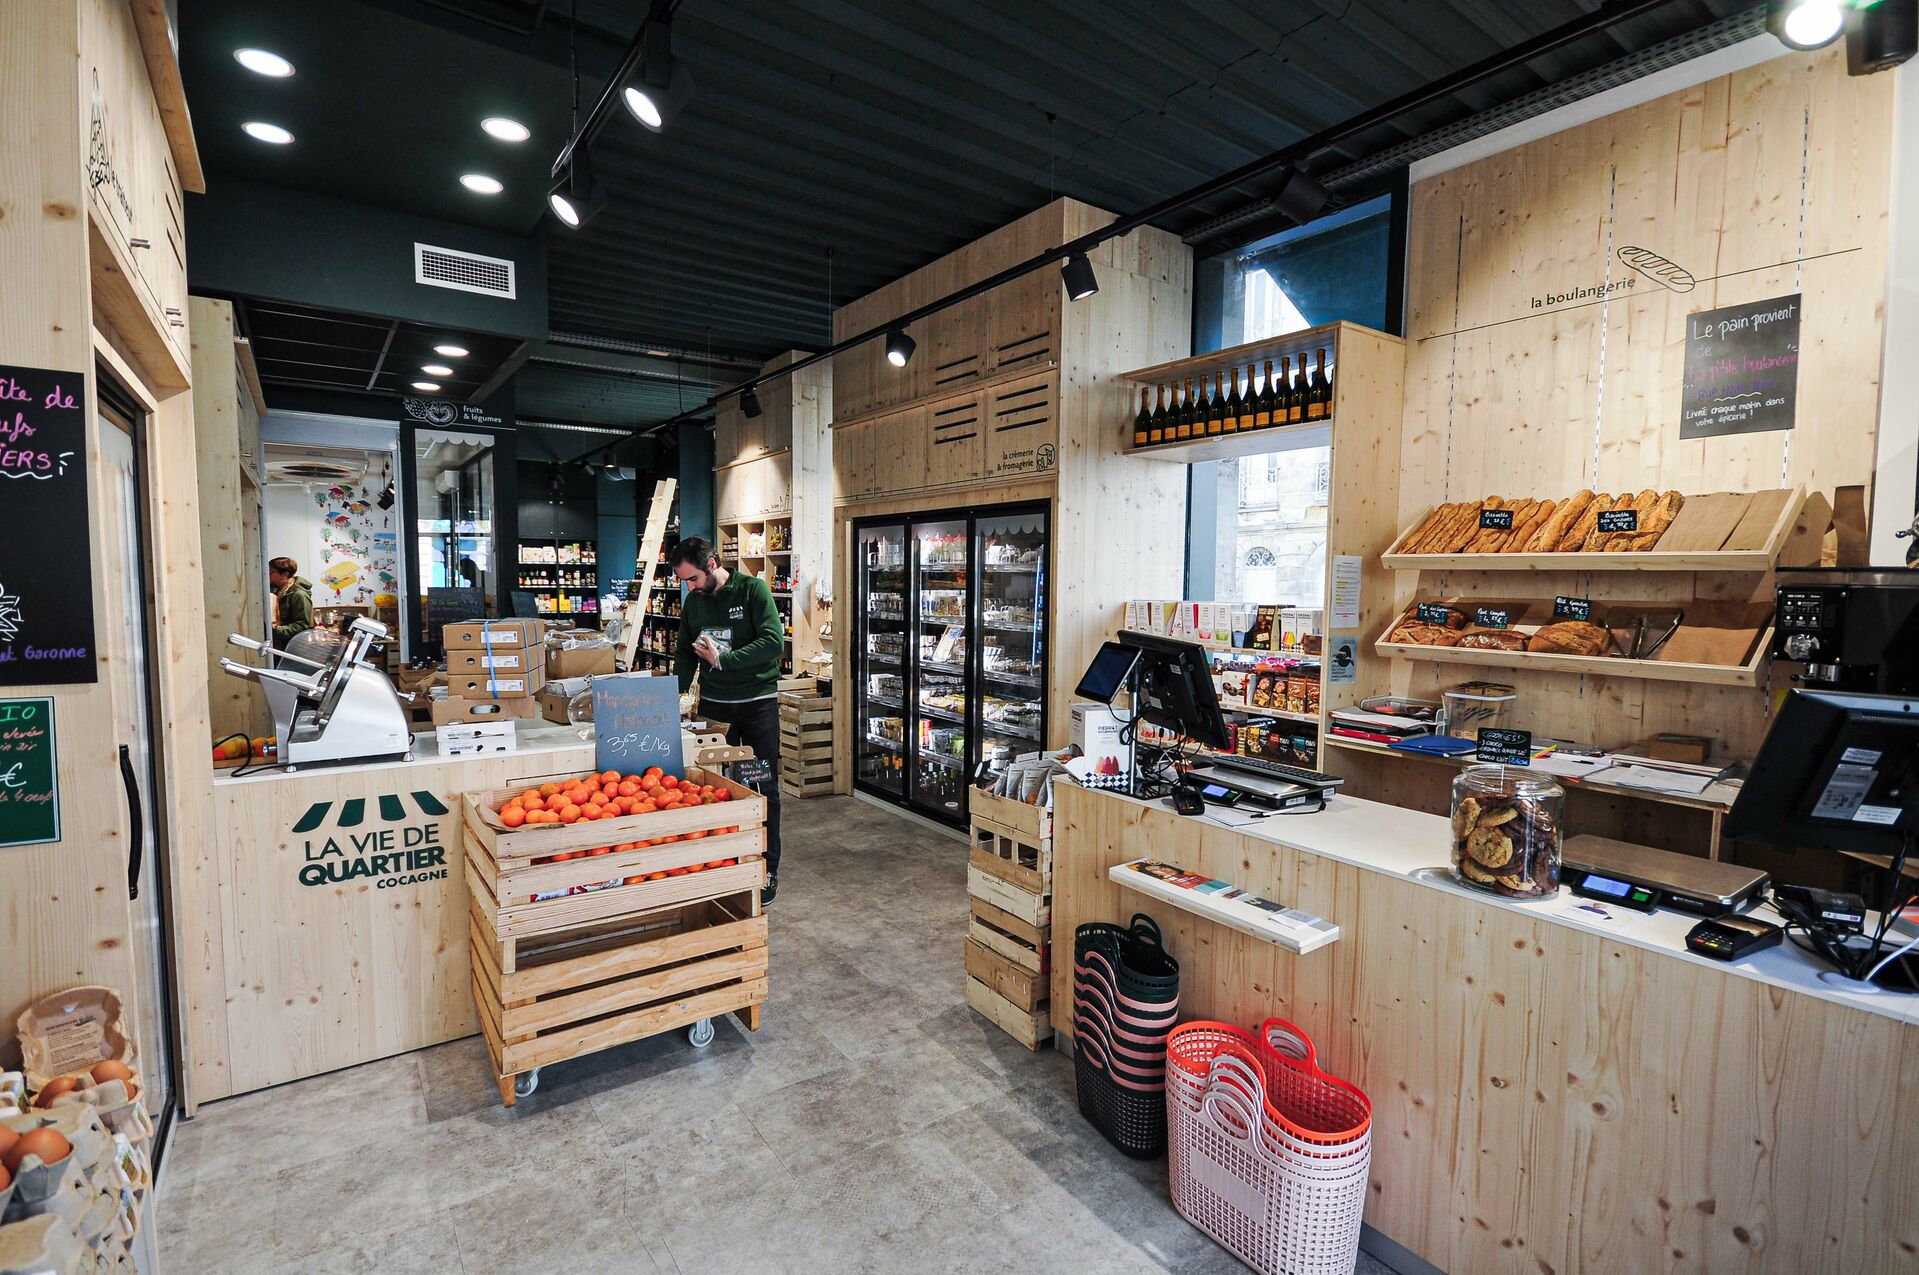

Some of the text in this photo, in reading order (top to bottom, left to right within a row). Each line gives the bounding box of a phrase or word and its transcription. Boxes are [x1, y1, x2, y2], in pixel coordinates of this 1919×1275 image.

[1531, 276, 1637, 308] la boulangerie
[1694, 304, 1797, 340] Le pain provient
[45, 385, 79, 409] de
[1711, 403, 1737, 416] chaque
[1739, 400, 1762, 411] matin
[1766, 397, 1785, 407] dans
[463, 405, 483, 415] fruits
[471, 411, 502, 423] légumes
[1003, 460, 1034, 471] fromagerie
[25, 645, 87, 661] Garonne
[305, 823, 440, 861] LA VIE DE
[298, 845, 448, 887] QUARTIER
[376, 868, 449, 889] COCAGNE
